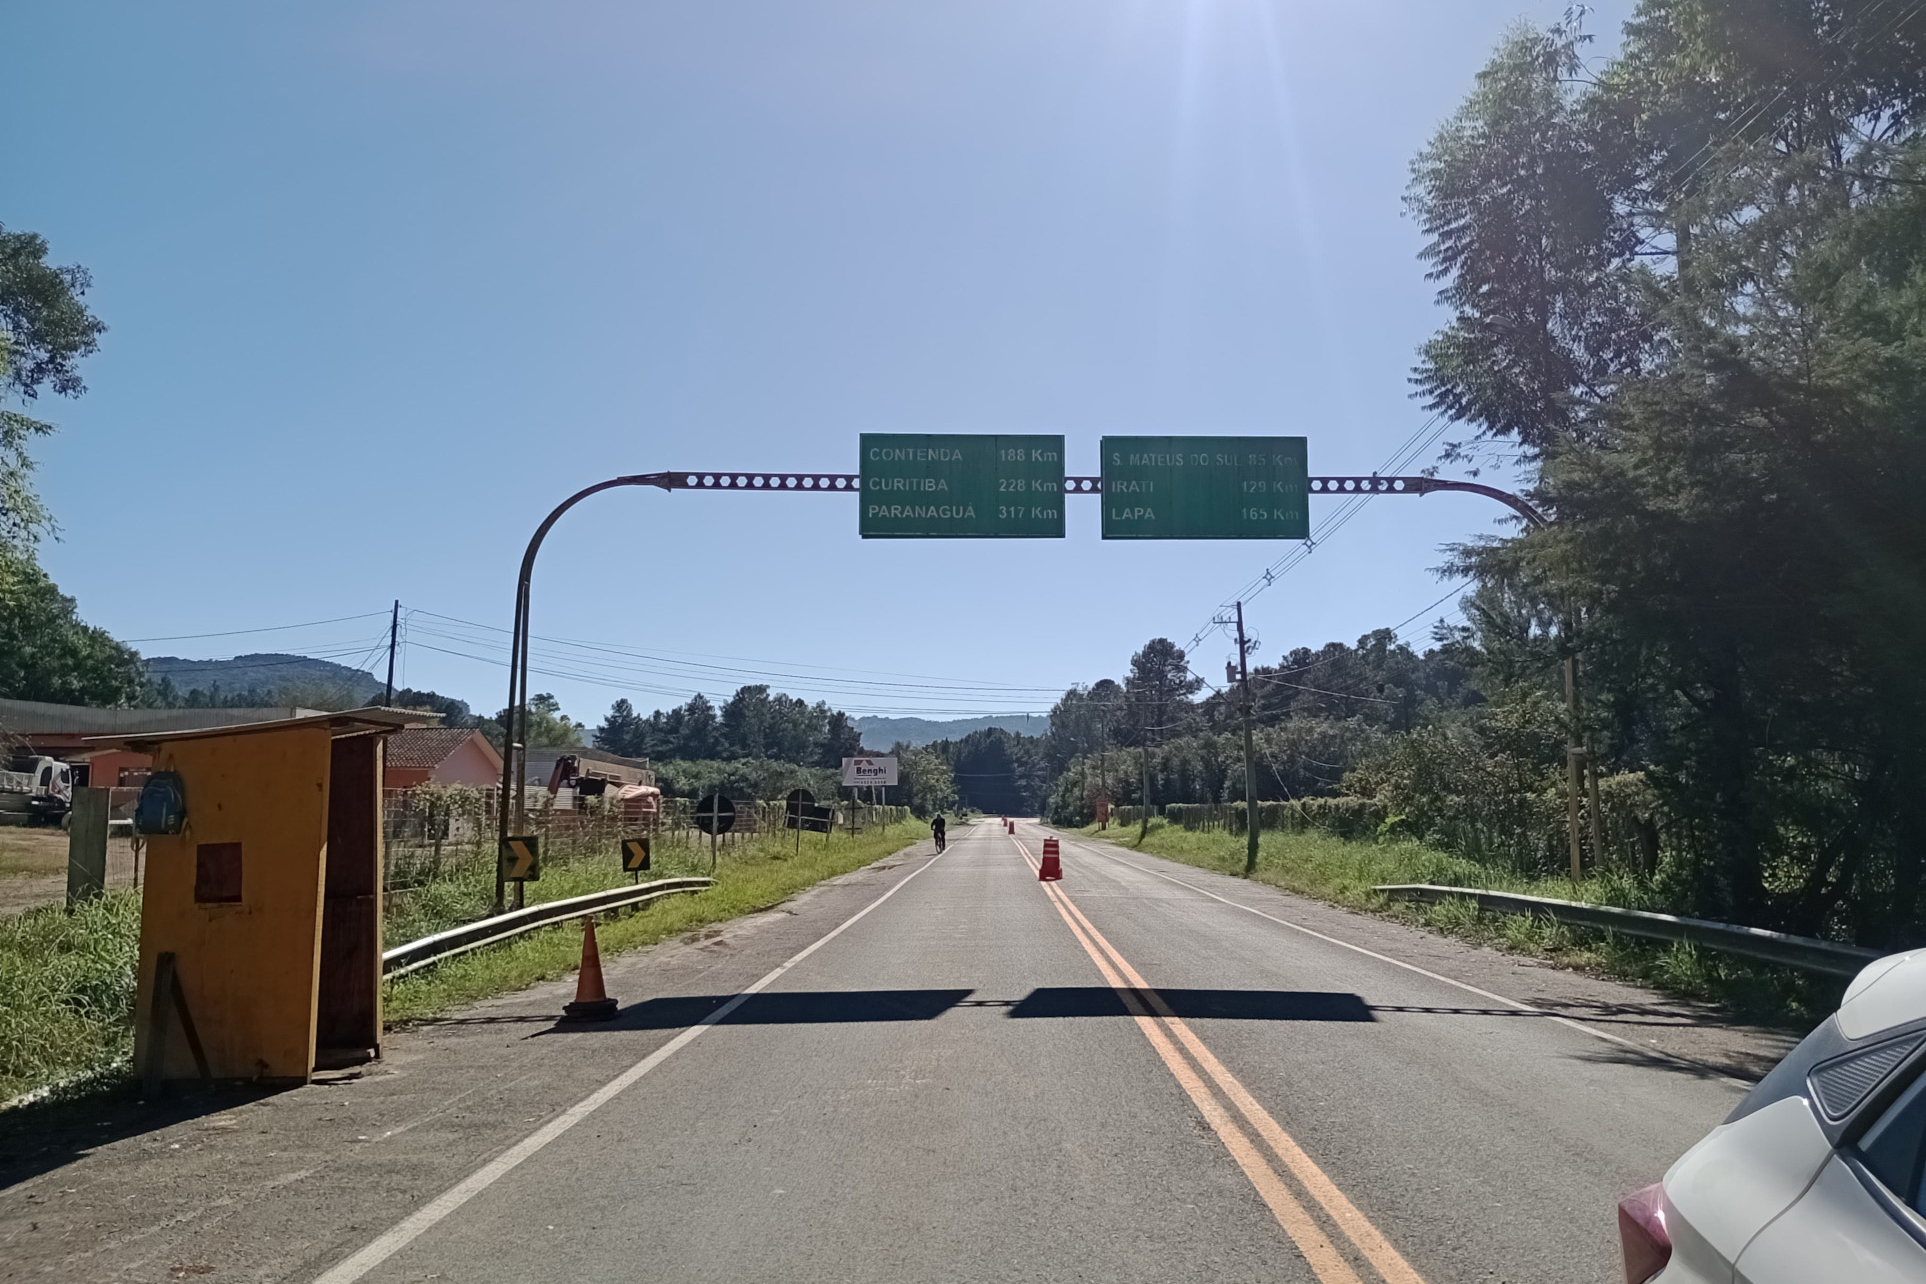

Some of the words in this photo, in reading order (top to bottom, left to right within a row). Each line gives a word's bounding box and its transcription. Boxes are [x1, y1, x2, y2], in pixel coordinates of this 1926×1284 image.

[870, 448, 962, 461] CONTENDA
[1000, 449, 1025, 461] 188
[1032, 449, 1057, 462] Km
[1112, 453, 1123, 466] S.
[1130, 453, 1184, 466] MATEUS
[1190, 454, 1208, 466] DO
[1216, 454, 1241, 466] SUL
[1248, 454, 1266, 466] 85
[1272, 454, 1298, 467] Km
[869, 478, 948, 491] CURITIBA
[999, 479, 1026, 492] 228
[1032, 480, 1057, 492] Km
[1112, 481, 1153, 493] IRATI
[1242, 481, 1266, 493] 129
[1273, 481, 1298, 493] Km
[868, 503, 976, 518] PARANAGUÁ
[999, 506, 1025, 519] 317
[1031, 507, 1057, 519] Km
[1112, 508, 1155, 520] LAPA
[1242, 508, 1267, 520] 165
[1273, 508, 1299, 520] Km
[856, 767, 887, 776] Benghi
